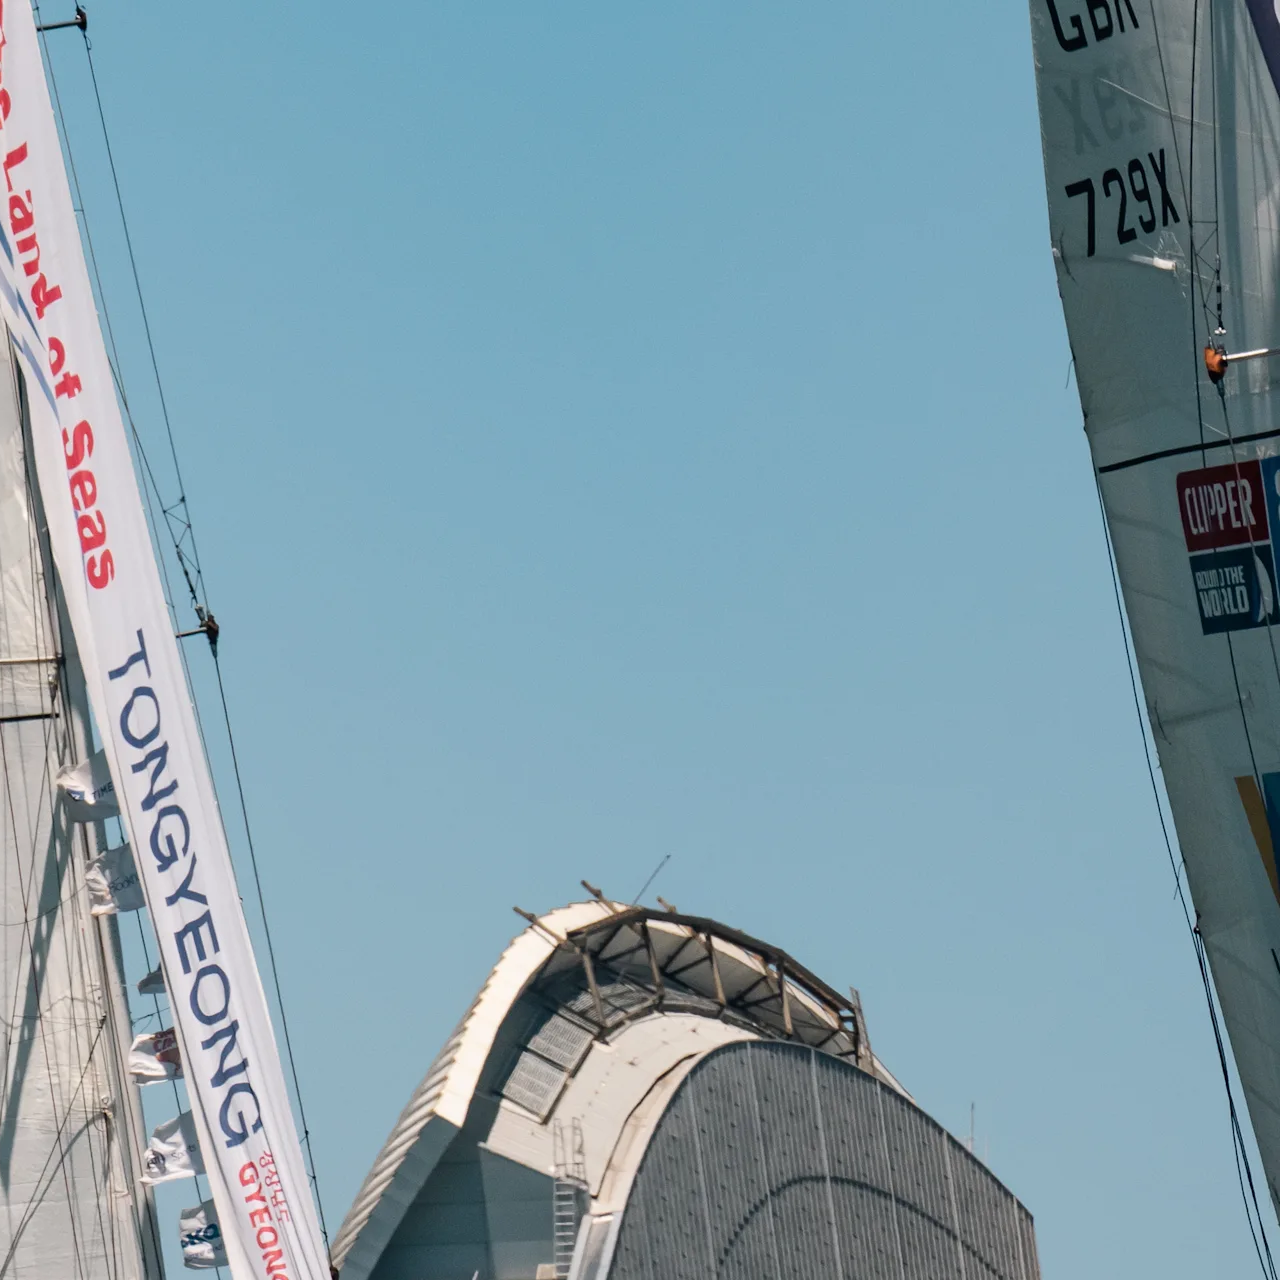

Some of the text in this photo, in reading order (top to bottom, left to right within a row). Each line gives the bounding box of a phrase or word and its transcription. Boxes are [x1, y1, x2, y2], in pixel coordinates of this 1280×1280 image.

[2, 141, 62, 321] Land
[1064, 148, 1181, 258] 729X
[46, 335, 83, 400] of
[60, 418, 116, 590] Seas
[1184, 478, 1257, 536] CLIPPER
[1199, 586, 1251, 618] WORLD
[1224, 565, 1246, 584] THE
[108, 628, 263, 1149] TONGYEONG
